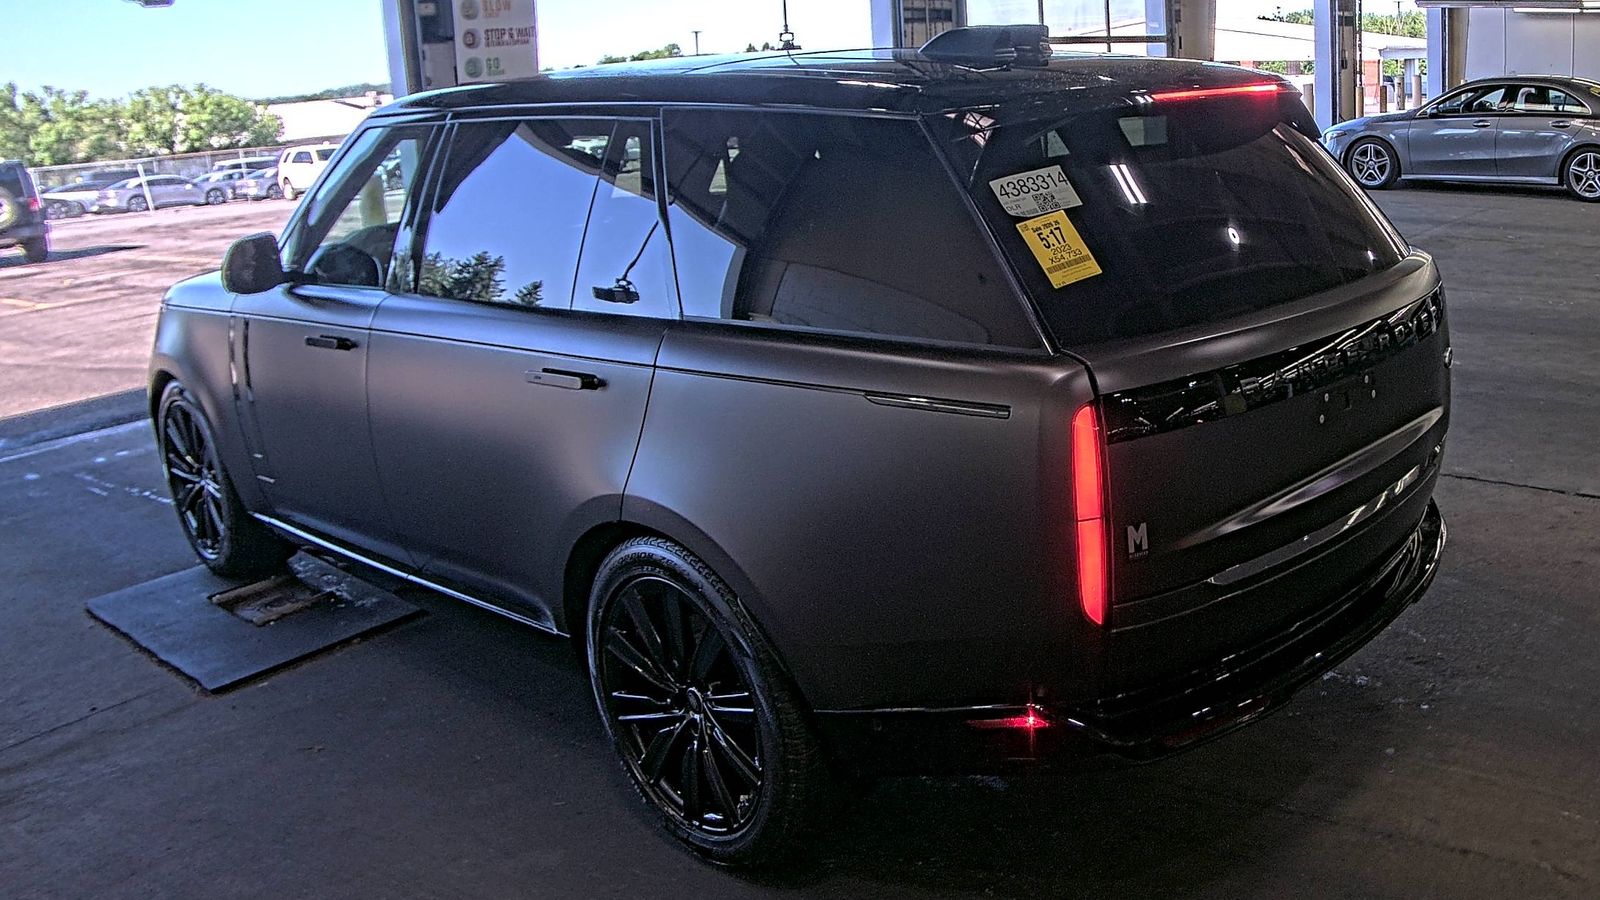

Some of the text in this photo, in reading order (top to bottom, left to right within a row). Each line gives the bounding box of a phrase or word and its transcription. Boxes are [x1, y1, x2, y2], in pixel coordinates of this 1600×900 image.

[484, 28, 506, 41] STOP
[515, 26, 535, 38] WAIT
[486, 57, 500, 70] GO
[999, 171, 1069, 199] 4383314
[1037, 226, 1066, 249] 5:17
[1051, 243, 1072, 256] 2023
[1127, 522, 1149, 554] M
